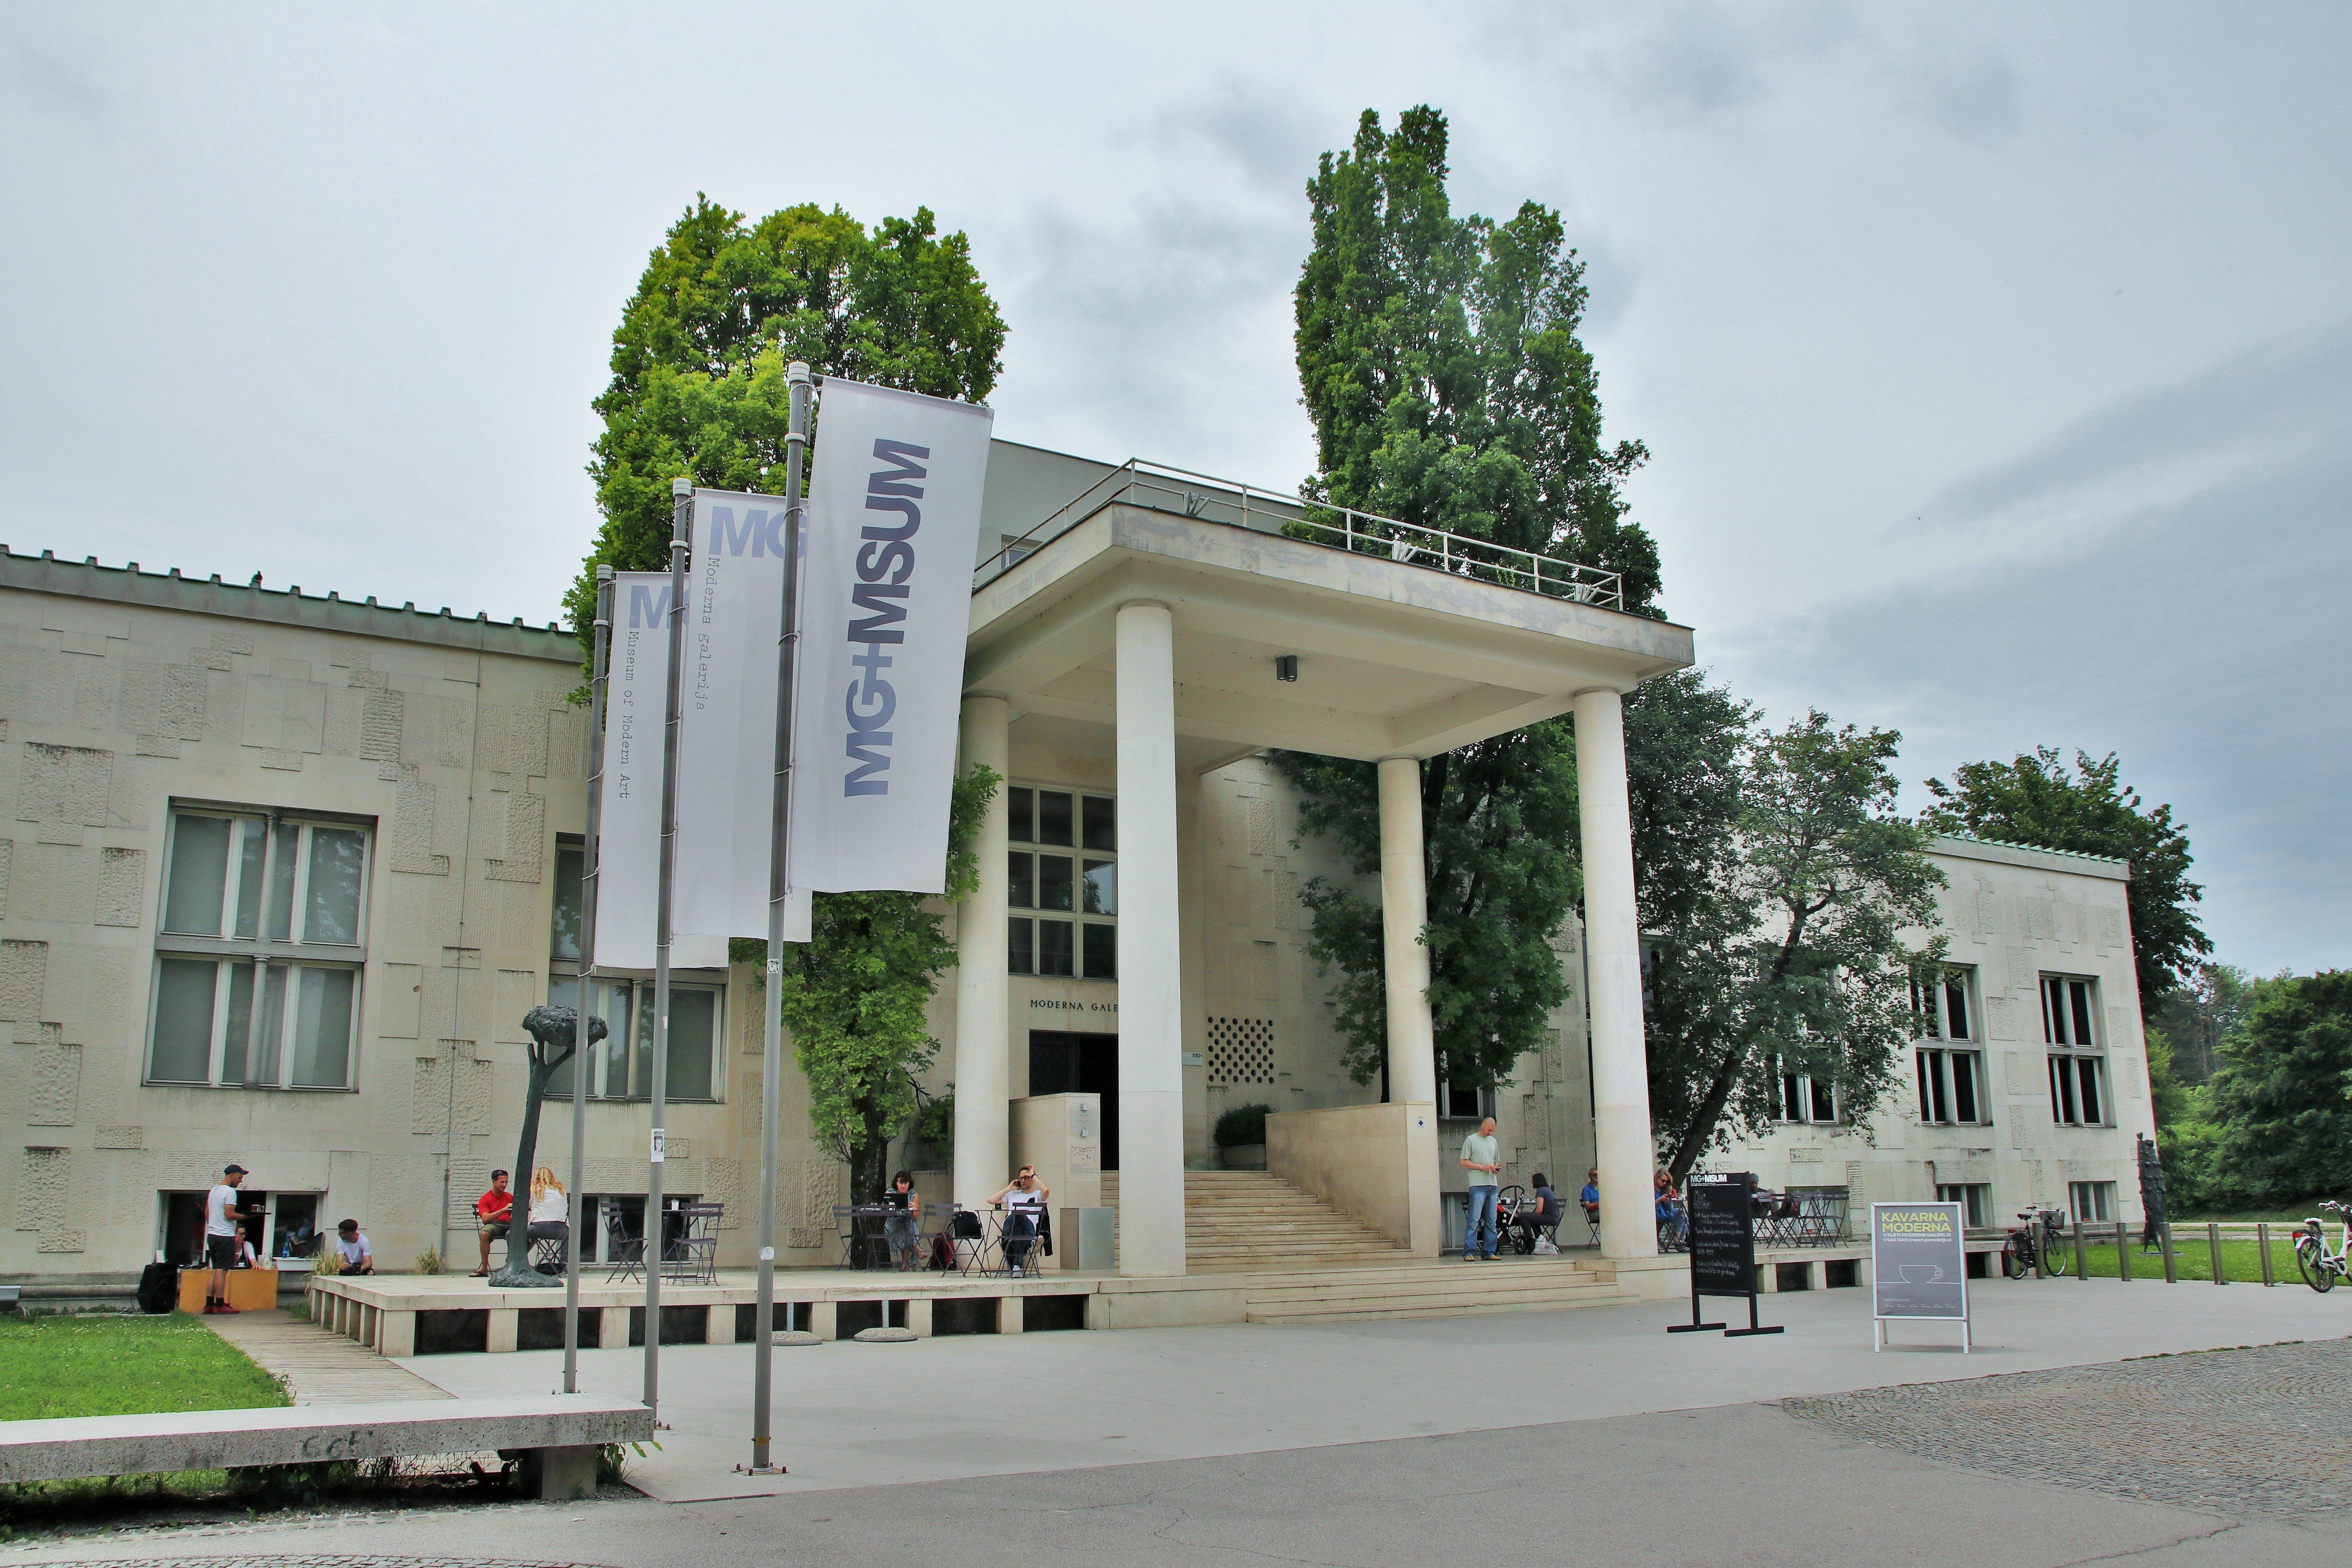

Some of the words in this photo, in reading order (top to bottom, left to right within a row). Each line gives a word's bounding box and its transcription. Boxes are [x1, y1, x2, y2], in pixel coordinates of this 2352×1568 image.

[628, 585, 690, 630] M
[702, 557, 720, 624] Moderna
[844, 438, 931, 797] MG+MSUM
[625, 631, 639, 681] Museum
[694, 633, 711, 710] galerija
[623, 690, 632, 706] of
[621, 715, 633, 765] Modern
[619, 773, 630, 799] Art
[1031, 1000, 1083, 1010] MODERNA
[1690, 1174, 1727, 1183] MG+MSUM
[1882, 1212, 1949, 1222] KAVARNA
[1882, 1222, 1952, 1232] MODERNA
